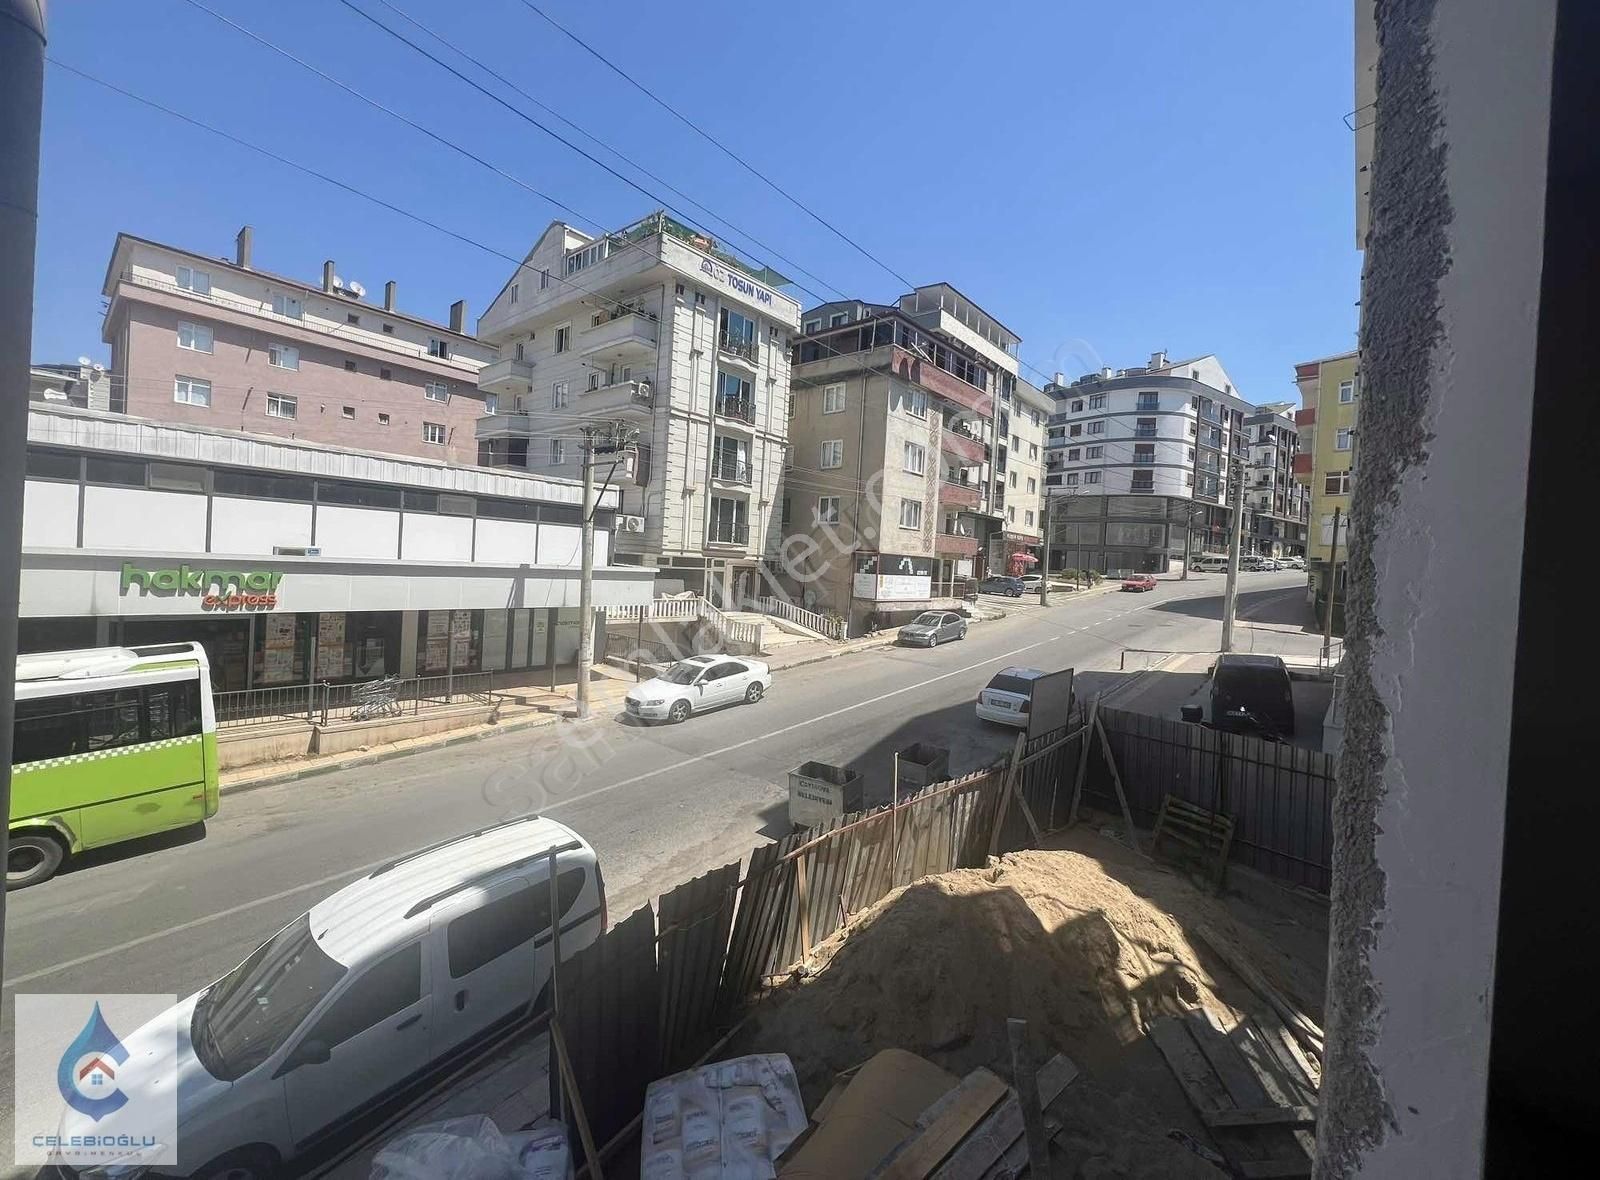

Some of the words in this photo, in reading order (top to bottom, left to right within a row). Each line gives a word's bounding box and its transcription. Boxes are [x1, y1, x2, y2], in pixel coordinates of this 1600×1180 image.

[728, 274, 754, 297] TOSUN
[756, 287, 772, 305] YAPI
[120, 562, 283, 597] hakmar
[201, 590, 278, 612] express
